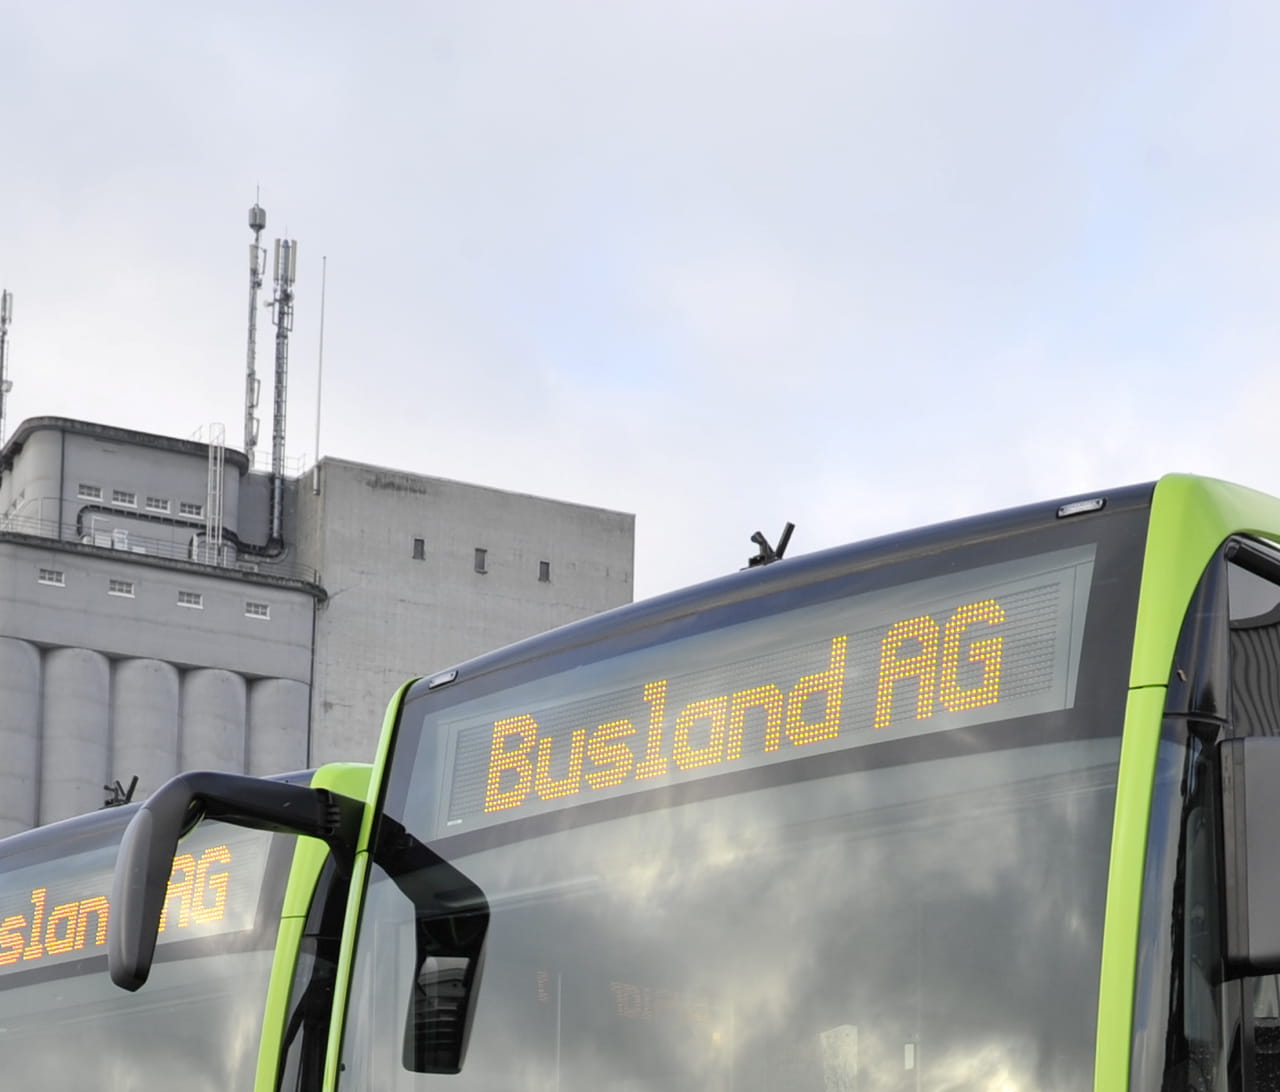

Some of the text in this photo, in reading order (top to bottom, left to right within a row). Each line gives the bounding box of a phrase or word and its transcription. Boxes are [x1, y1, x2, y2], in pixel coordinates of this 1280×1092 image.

[484, 599, 1006, 813] Busland AG
[158, 845, 232, 932] AG
